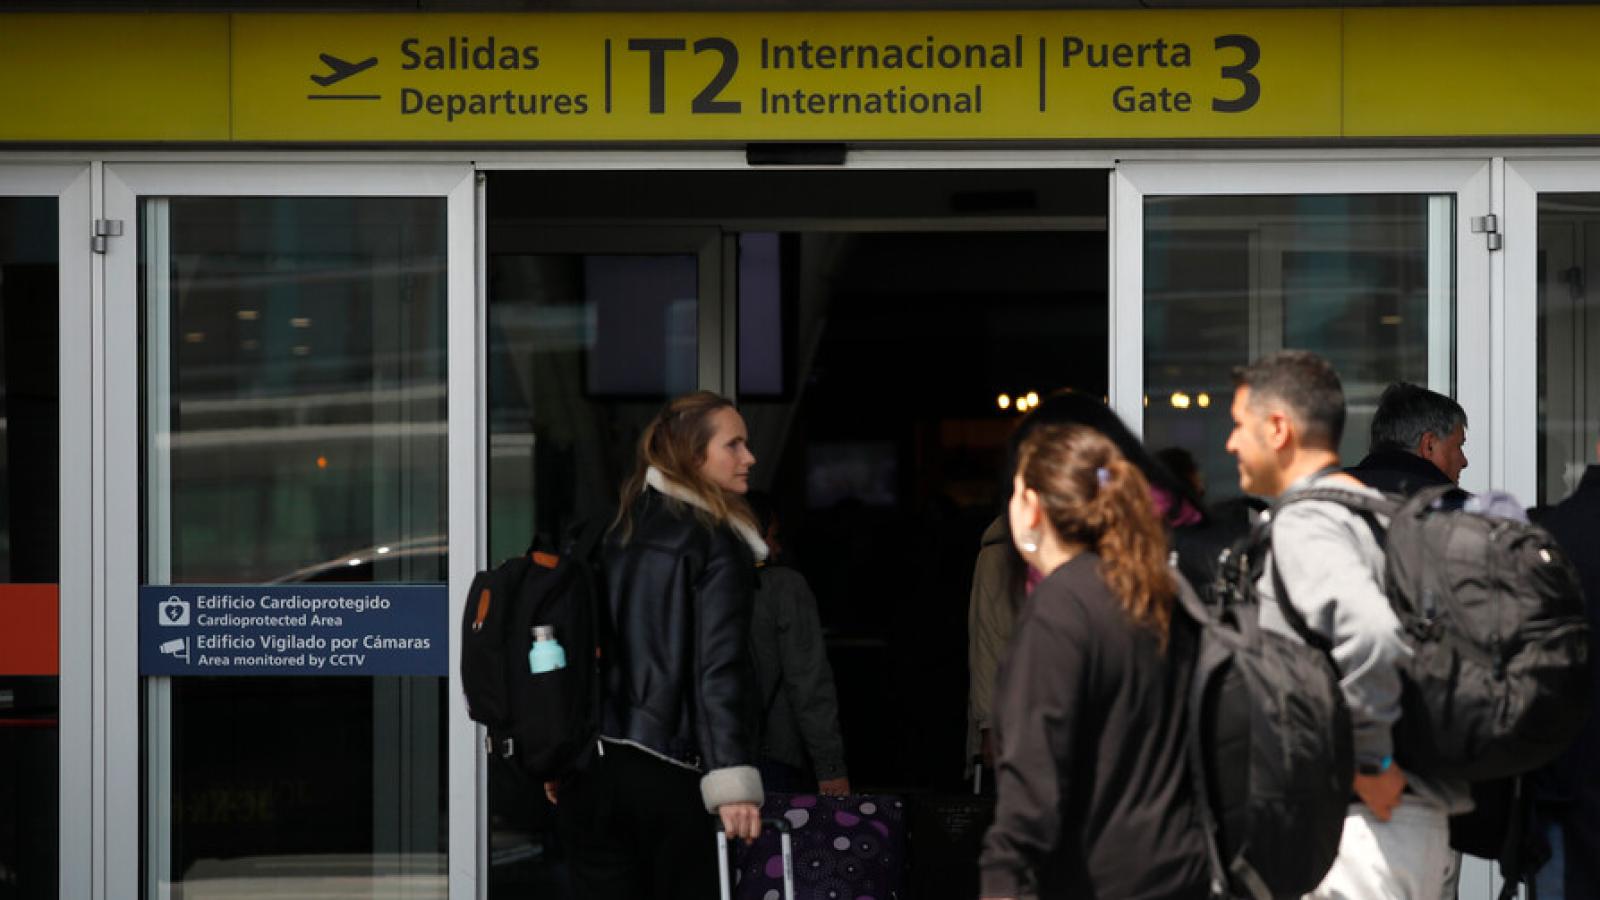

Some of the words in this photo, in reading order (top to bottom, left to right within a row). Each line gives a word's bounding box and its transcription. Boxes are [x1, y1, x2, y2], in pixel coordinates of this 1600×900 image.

[400, 35, 540, 71] Salidas
[760, 34, 1023, 69] Internacional
[1062, 36, 1191, 68] Puerta
[627, 37, 742, 114] T2
[1211, 34, 1261, 113] 3
[400, 87, 588, 122] Departures
[761, 85, 982, 114] International
[1112, 85, 1191, 113] Gate
[197, 595, 255, 609] Edificio
[260, 595, 391, 612] Cardioprotegido
[197, 613, 307, 628] Cardioprotected
[310, 614, 343, 626] Area
[197, 634, 255, 649] Edificio
[260, 634, 327, 652] Vigilado
[330, 638, 359, 652] por
[362, 634, 431, 649] Cámaras
[198, 654, 230, 666] Area
[234, 654, 305, 666] monitored
[309, 654, 325, 668] by
[329, 654, 366, 666] CCTV
